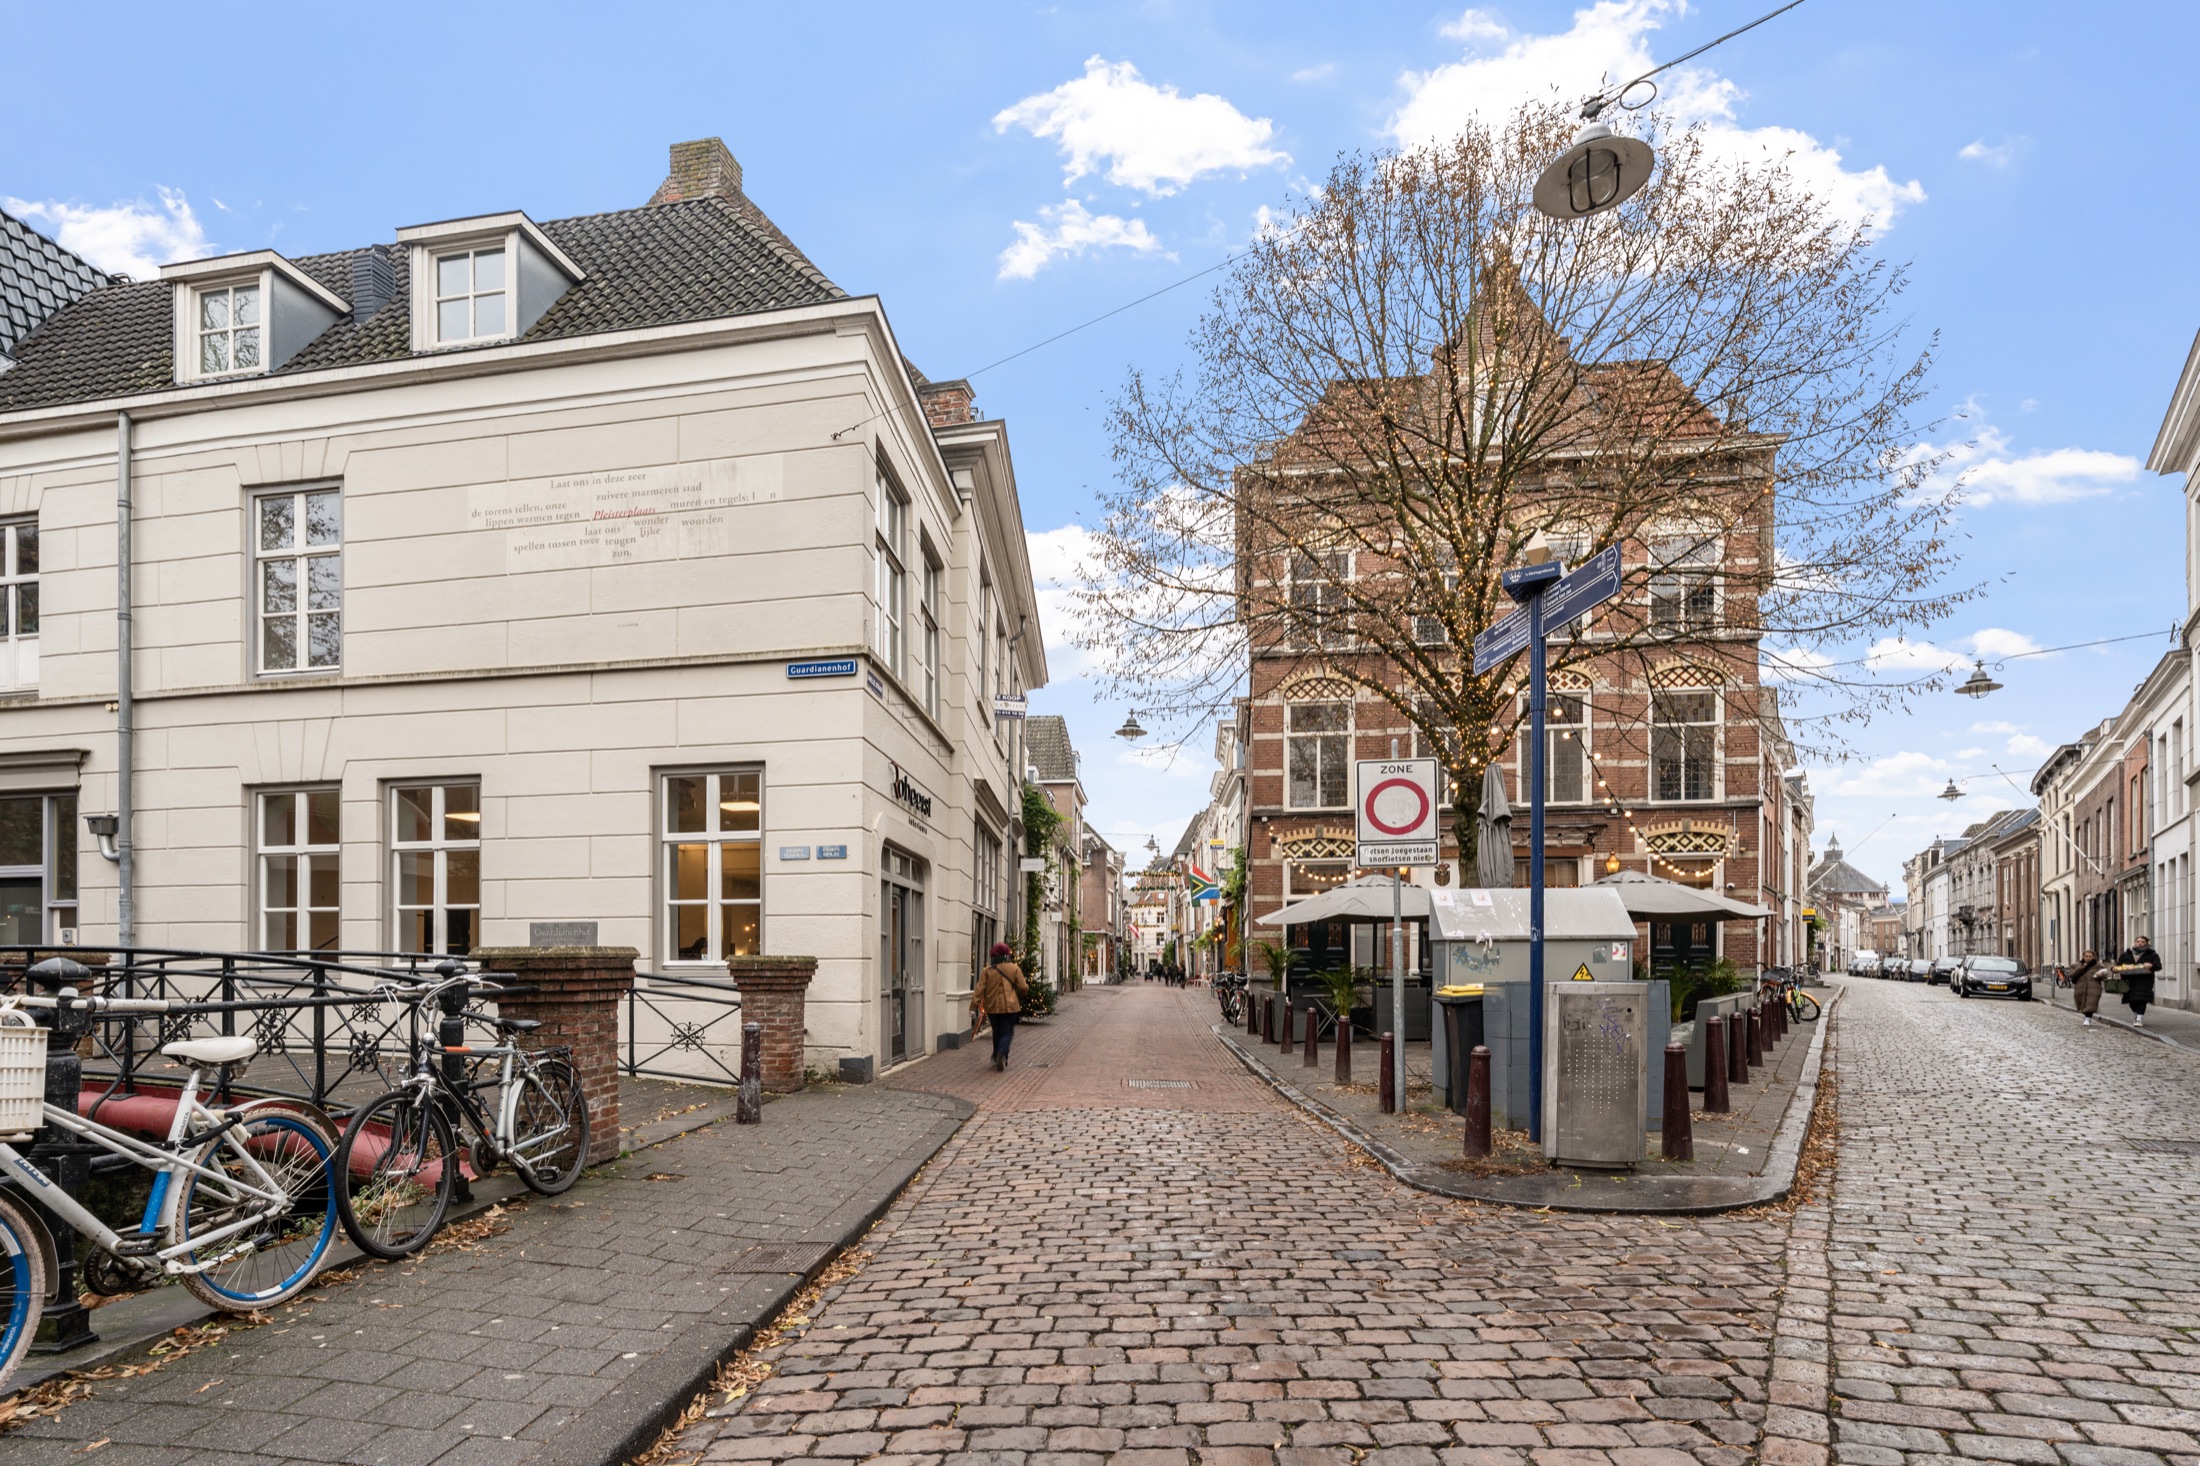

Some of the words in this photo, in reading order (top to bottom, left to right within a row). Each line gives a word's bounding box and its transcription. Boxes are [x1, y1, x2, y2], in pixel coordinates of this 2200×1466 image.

[550, 480, 571, 489] Laat
[592, 476, 602, 485] in
[604, 474, 625, 483] deze
[628, 472, 646, 482] zeer
[596, 489, 630, 501] zuivere
[632, 486, 680, 498] marmeren
[682, 482, 702, 492] stad
[471, 508, 483, 518] de
[485, 507, 512, 516] torens
[546, 502, 567, 511] onze
[670, 500, 701, 509] muren
[704, 498, 716, 506] en
[485, 517, 514, 528] lippen
[517, 514, 553, 524] warmen
[556, 511, 580, 521] tegen
[592, 506, 656, 521] Pleisterplaats
[634, 516, 670, 526] wonder
[682, 515, 724, 526] woorden
[585, 526, 602, 536] laat
[514, 542, 545, 554] spellen
[548, 540, 576, 549] tussen
[580, 537, 600, 546] twee
[605, 537, 636, 548] teugen
[790, 663, 851, 675] Guardianenhof
[1380, 764, 1413, 774] ZONE
[1369, 855, 1411, 863] snorfietsen
[177, 1111, 190, 1138] SPARTA
